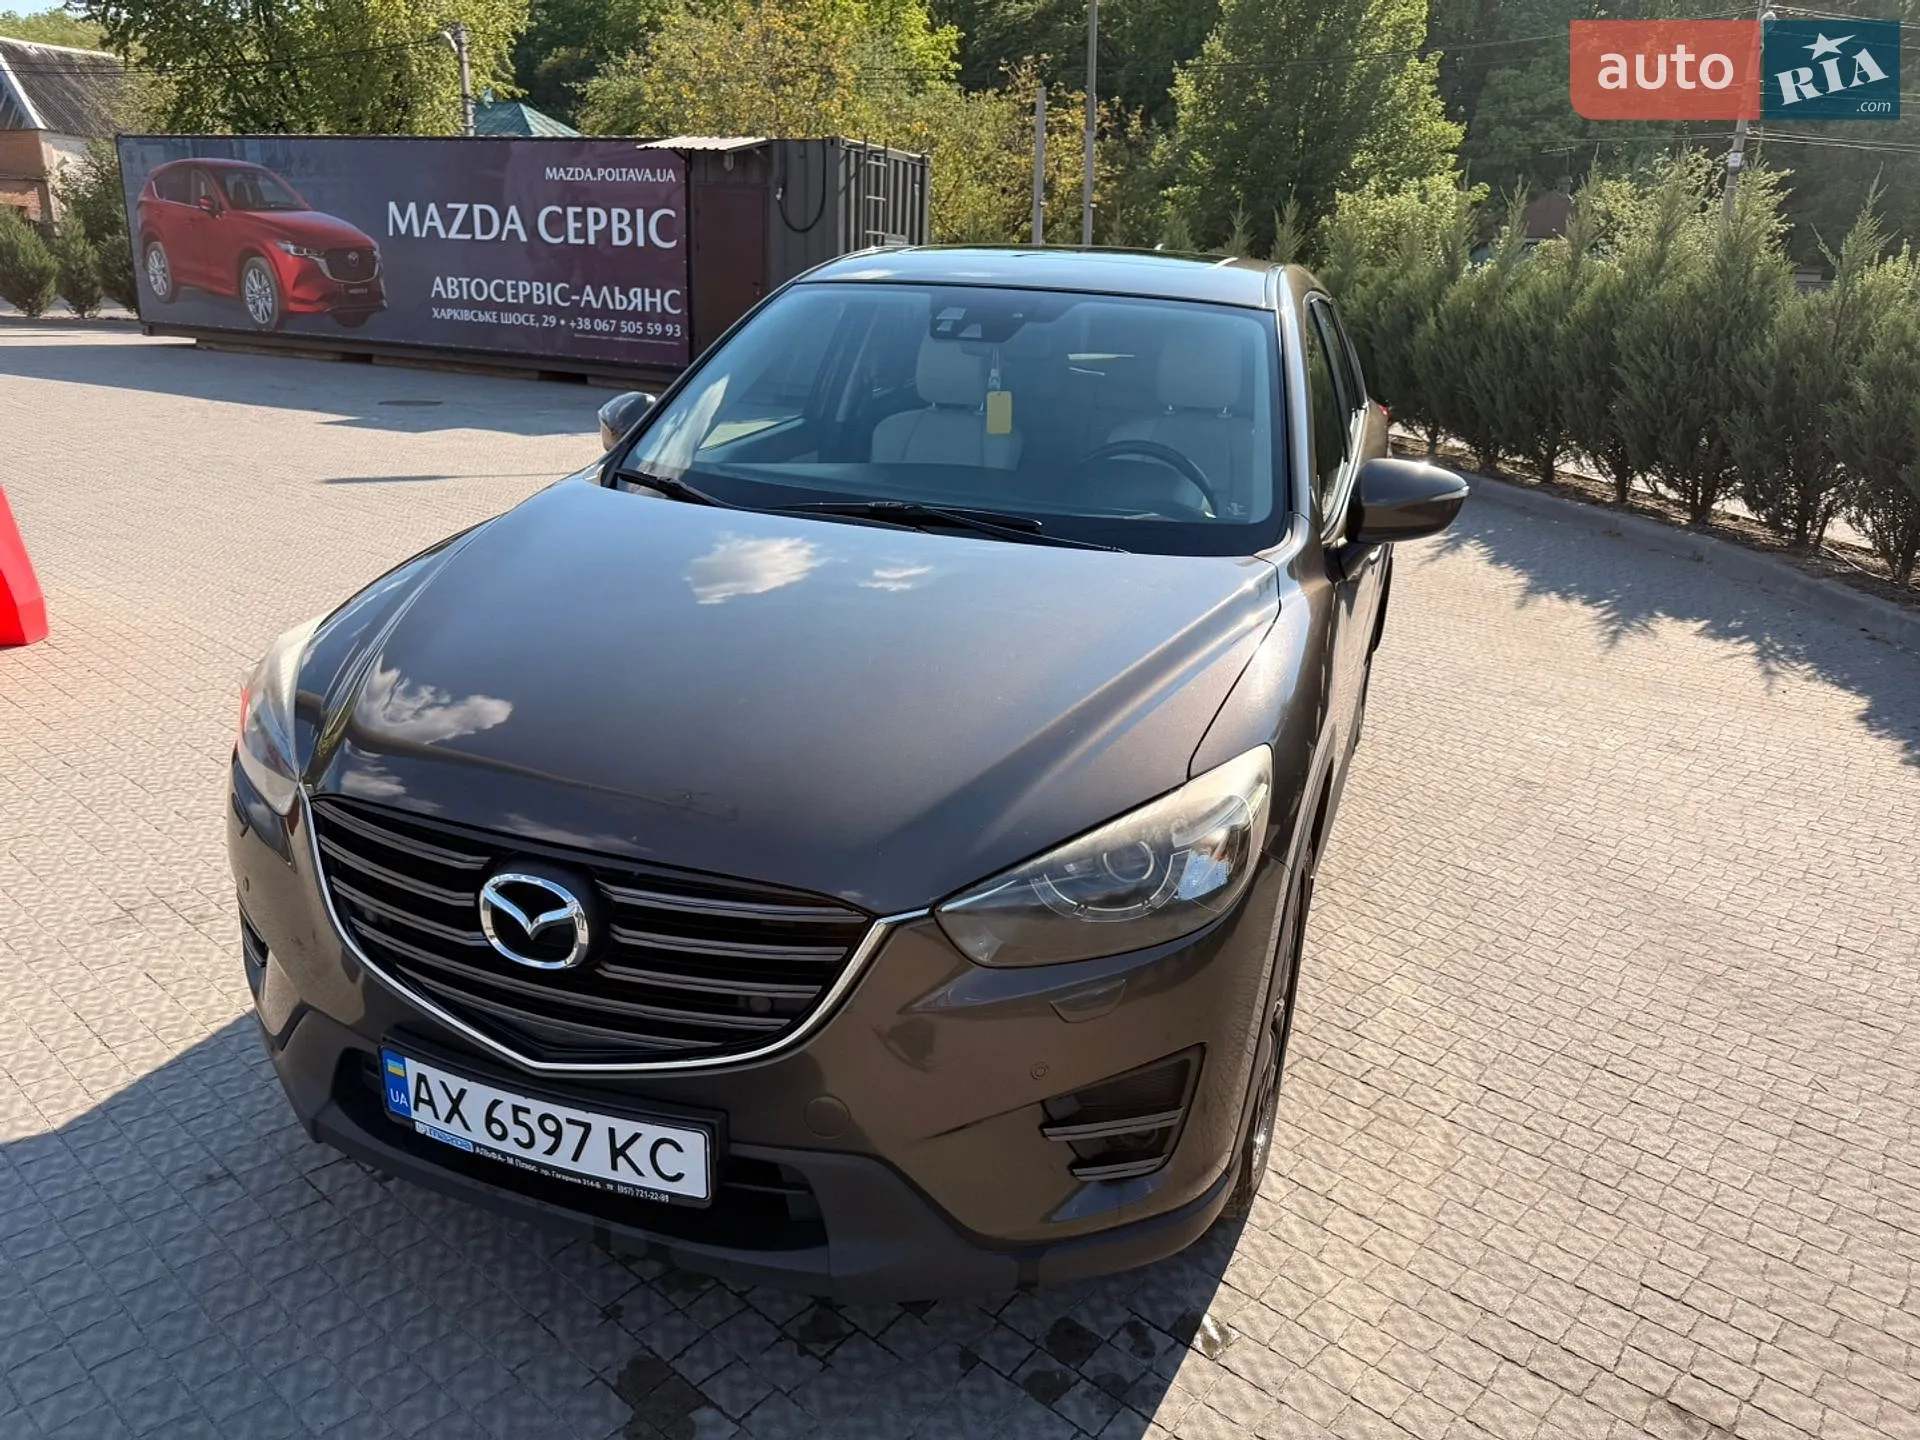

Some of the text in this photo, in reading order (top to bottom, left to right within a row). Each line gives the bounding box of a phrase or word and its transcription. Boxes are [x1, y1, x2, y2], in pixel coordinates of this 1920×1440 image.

[545, 166, 677, 183] MAZDA.POLTAVA.UA
[387, 200, 678, 249] MAZDA СЕРВІС
[430, 275, 683, 315] АВТОСЕРВІС-АЛЬЯНС
[431, 307, 682, 338] ХАРКІВСЬКЕ ШОСЕ, 29 +38 067 505 59 93
[390, 1088, 409, 1108] UA
[413, 1071, 686, 1183] AX 6597 KC
